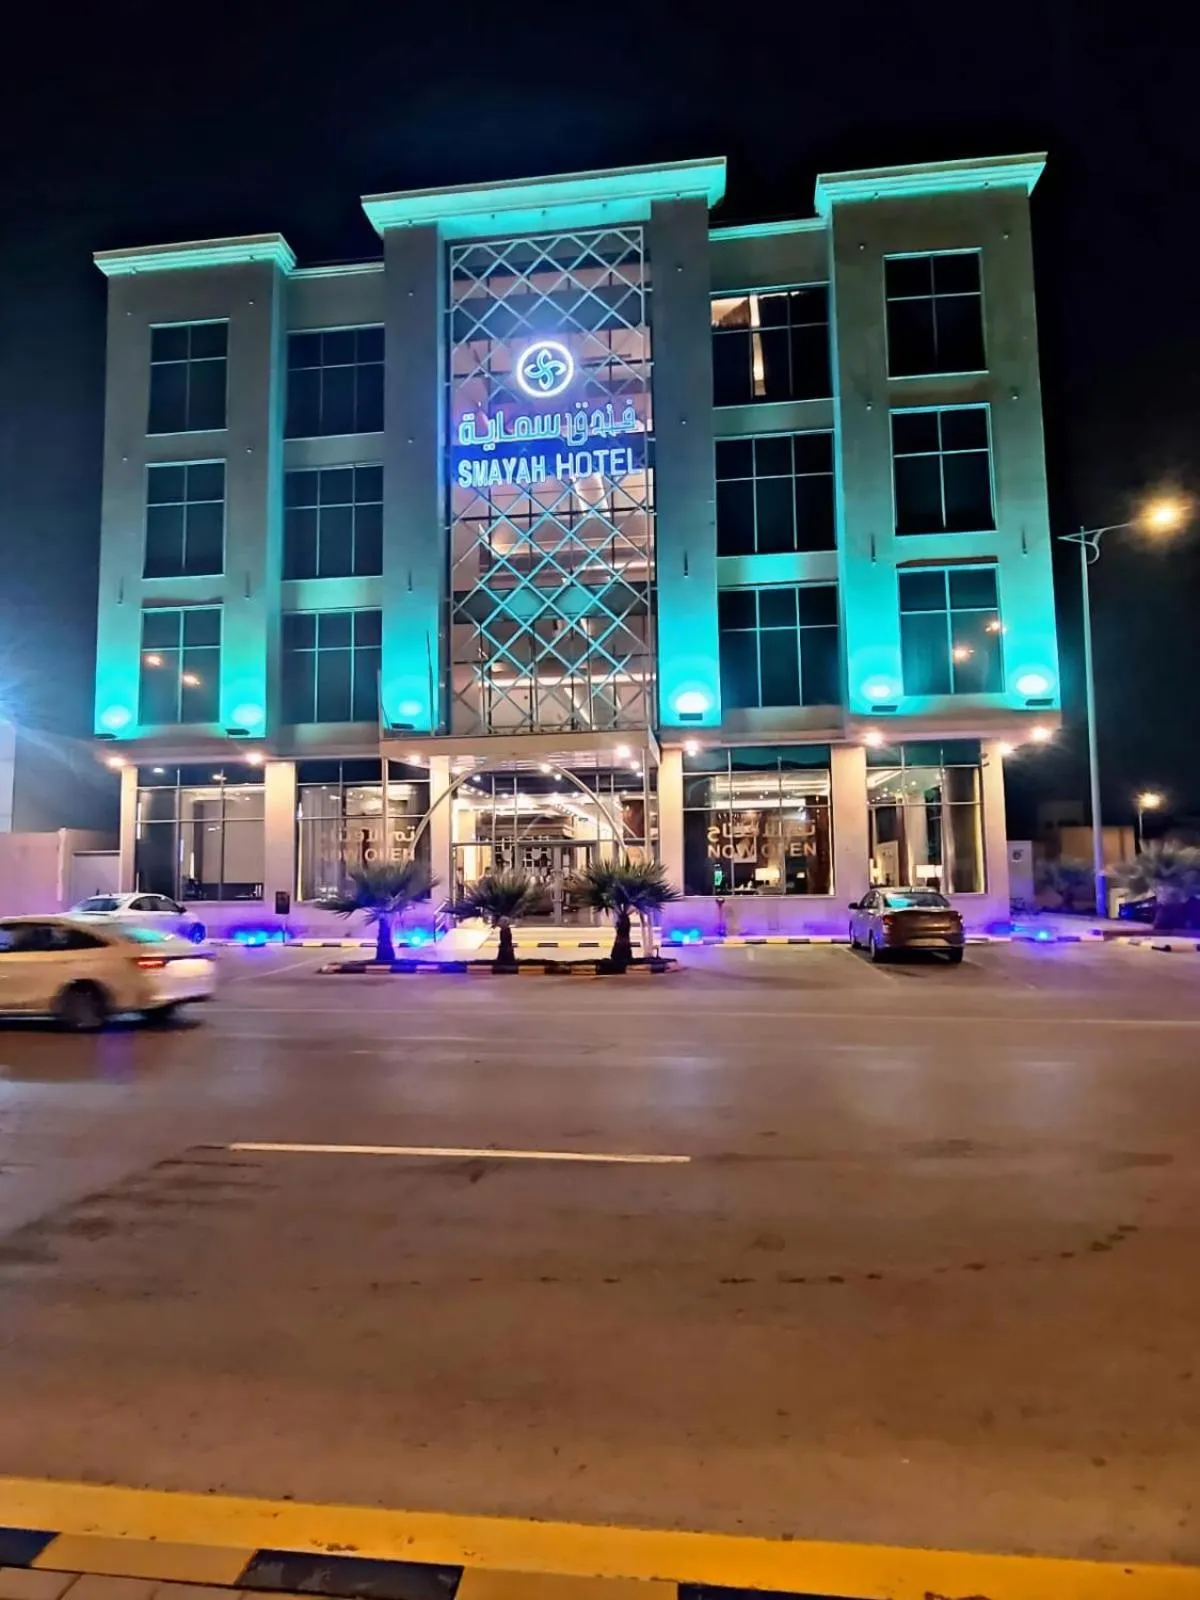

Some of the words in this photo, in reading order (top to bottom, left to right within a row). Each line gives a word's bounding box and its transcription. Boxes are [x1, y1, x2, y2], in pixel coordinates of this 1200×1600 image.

[459, 410, 561, 451] سماية
[565, 399, 636, 446] فندق
[458, 454, 546, 488] SMAYAH
[556, 447, 642, 481] HOTEL
[707, 843, 756, 859] NOW
